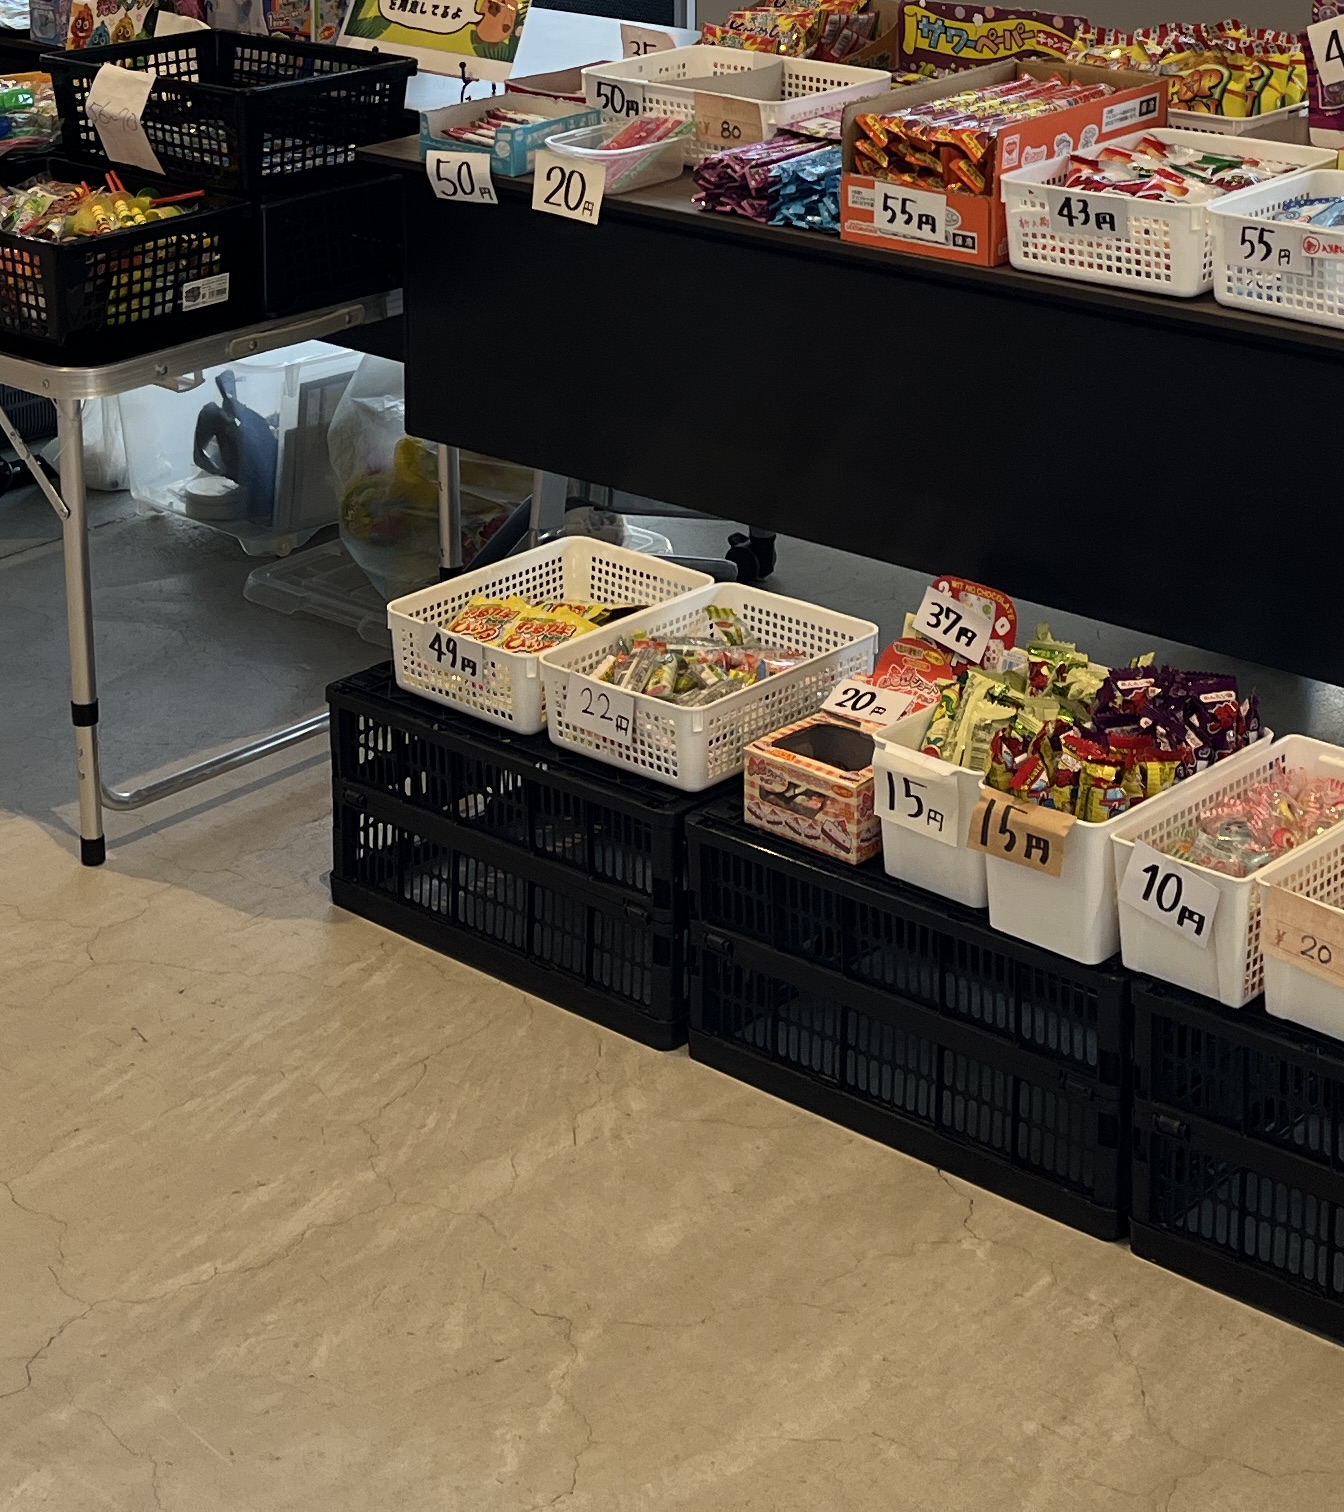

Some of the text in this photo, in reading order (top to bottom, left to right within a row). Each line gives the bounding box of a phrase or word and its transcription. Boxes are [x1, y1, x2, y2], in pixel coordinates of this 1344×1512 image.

[596, 80, 640, 118] 50円
[719, 120, 743, 141] 80
[436, 157, 493, 202] 50円
[542, 165, 596, 219] 20円
[880, 192, 938, 235] 55円
[1056, 196, 1116, 233] 43円
[1238, 225, 1293, 268] 55円
[925, 602, 978, 649] 37円
[428, 634, 478, 678] 49円
[580, 687, 630, 738] 22円
[840, 687, 888, 716] 20円
[887, 771, 946, 833] 15円
[982, 798, 1051, 865] 15円
[1141, 863, 1207, 937] 10円
[1300, 934, 1333, 965] 20
